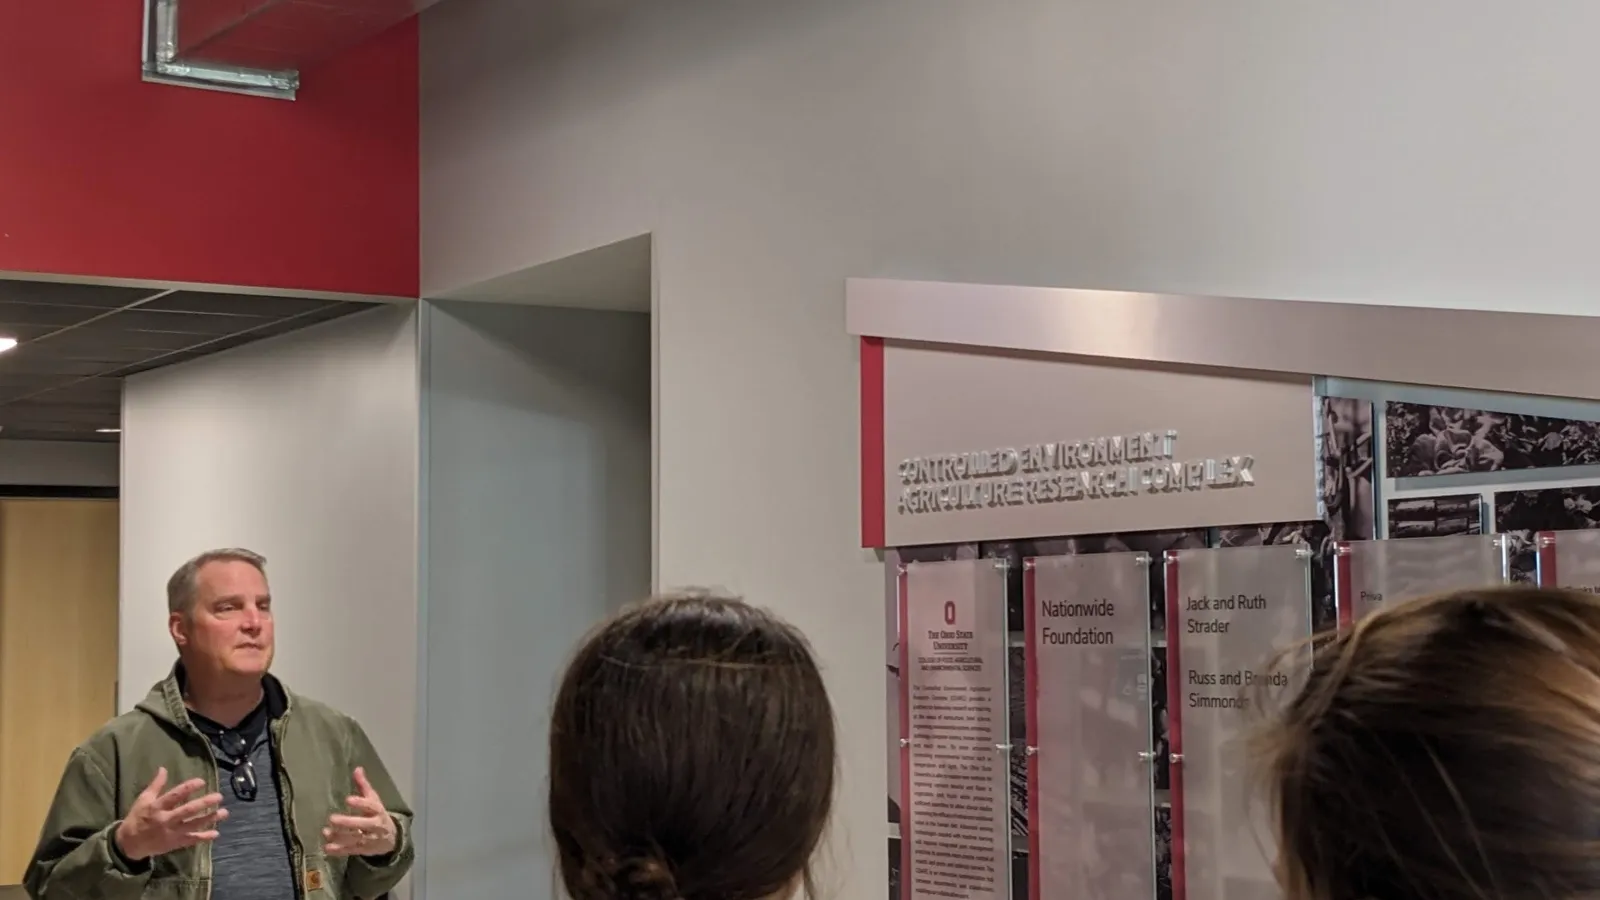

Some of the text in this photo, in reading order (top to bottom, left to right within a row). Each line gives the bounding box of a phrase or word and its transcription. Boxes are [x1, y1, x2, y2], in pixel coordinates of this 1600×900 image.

[898, 429, 1178, 484] CONTROLLED ENVIRONMENT
[898, 455, 1255, 514] AGRICULTURE RESEARCH COMPLEX
[1041, 598, 1115, 618] Nationwide
[1186, 594, 1267, 611] Jack and Ruth
[1187, 619, 1230, 634] Strader
[1042, 627, 1114, 645] Foundation
[1188, 670, 1288, 687] Russ and Bnda
